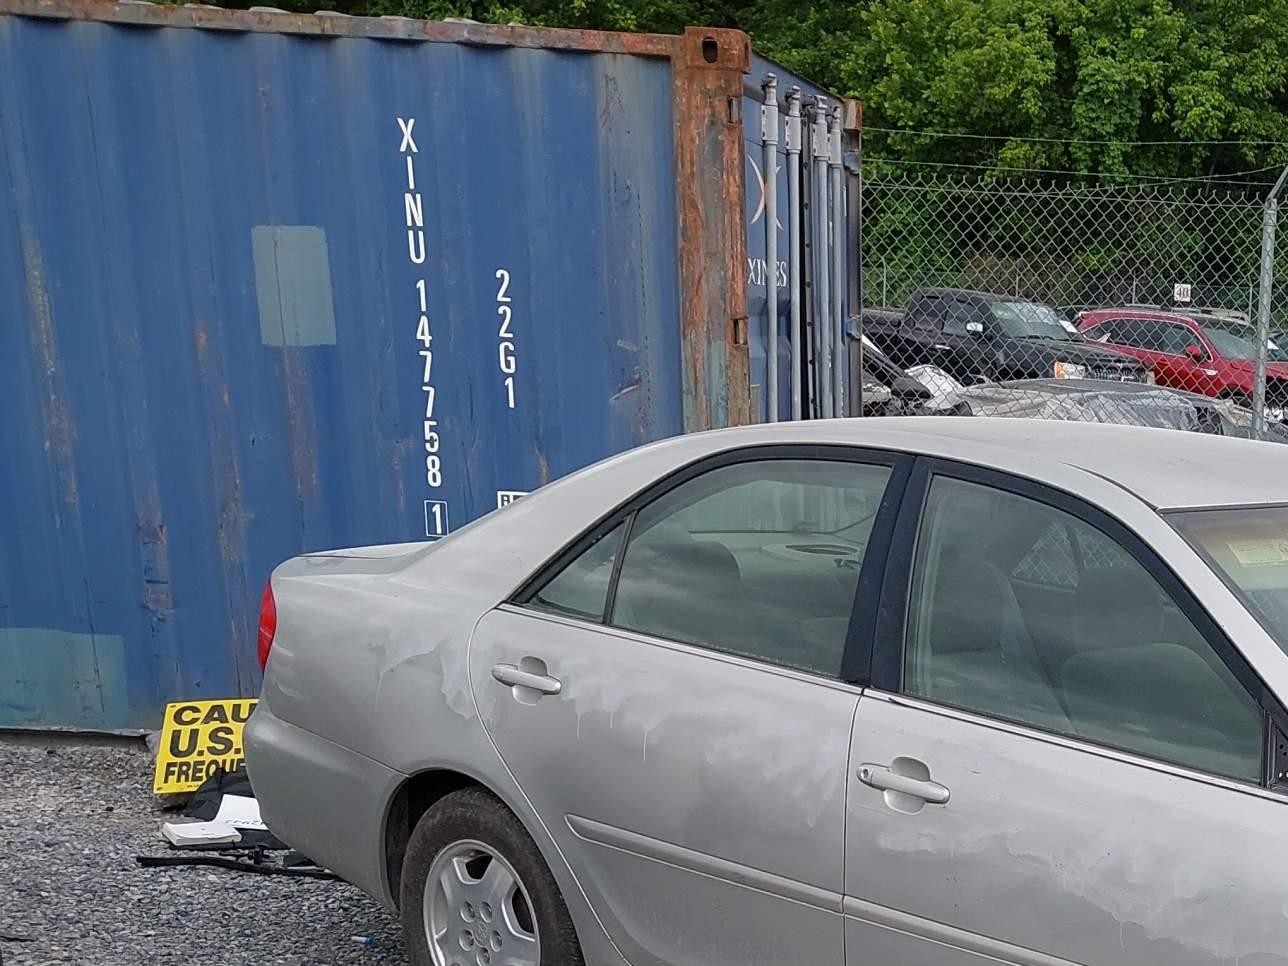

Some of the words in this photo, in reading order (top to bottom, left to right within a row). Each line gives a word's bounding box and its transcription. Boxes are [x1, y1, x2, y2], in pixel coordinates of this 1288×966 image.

[398, 118, 425, 263] XINU
[417, 280, 441, 486] 147758
[432, 503, 442, 534] 1
[496, 270, 515, 408] 22G1
[170, 727, 241, 758] U.S.
[174, 704, 257, 725] CAU
